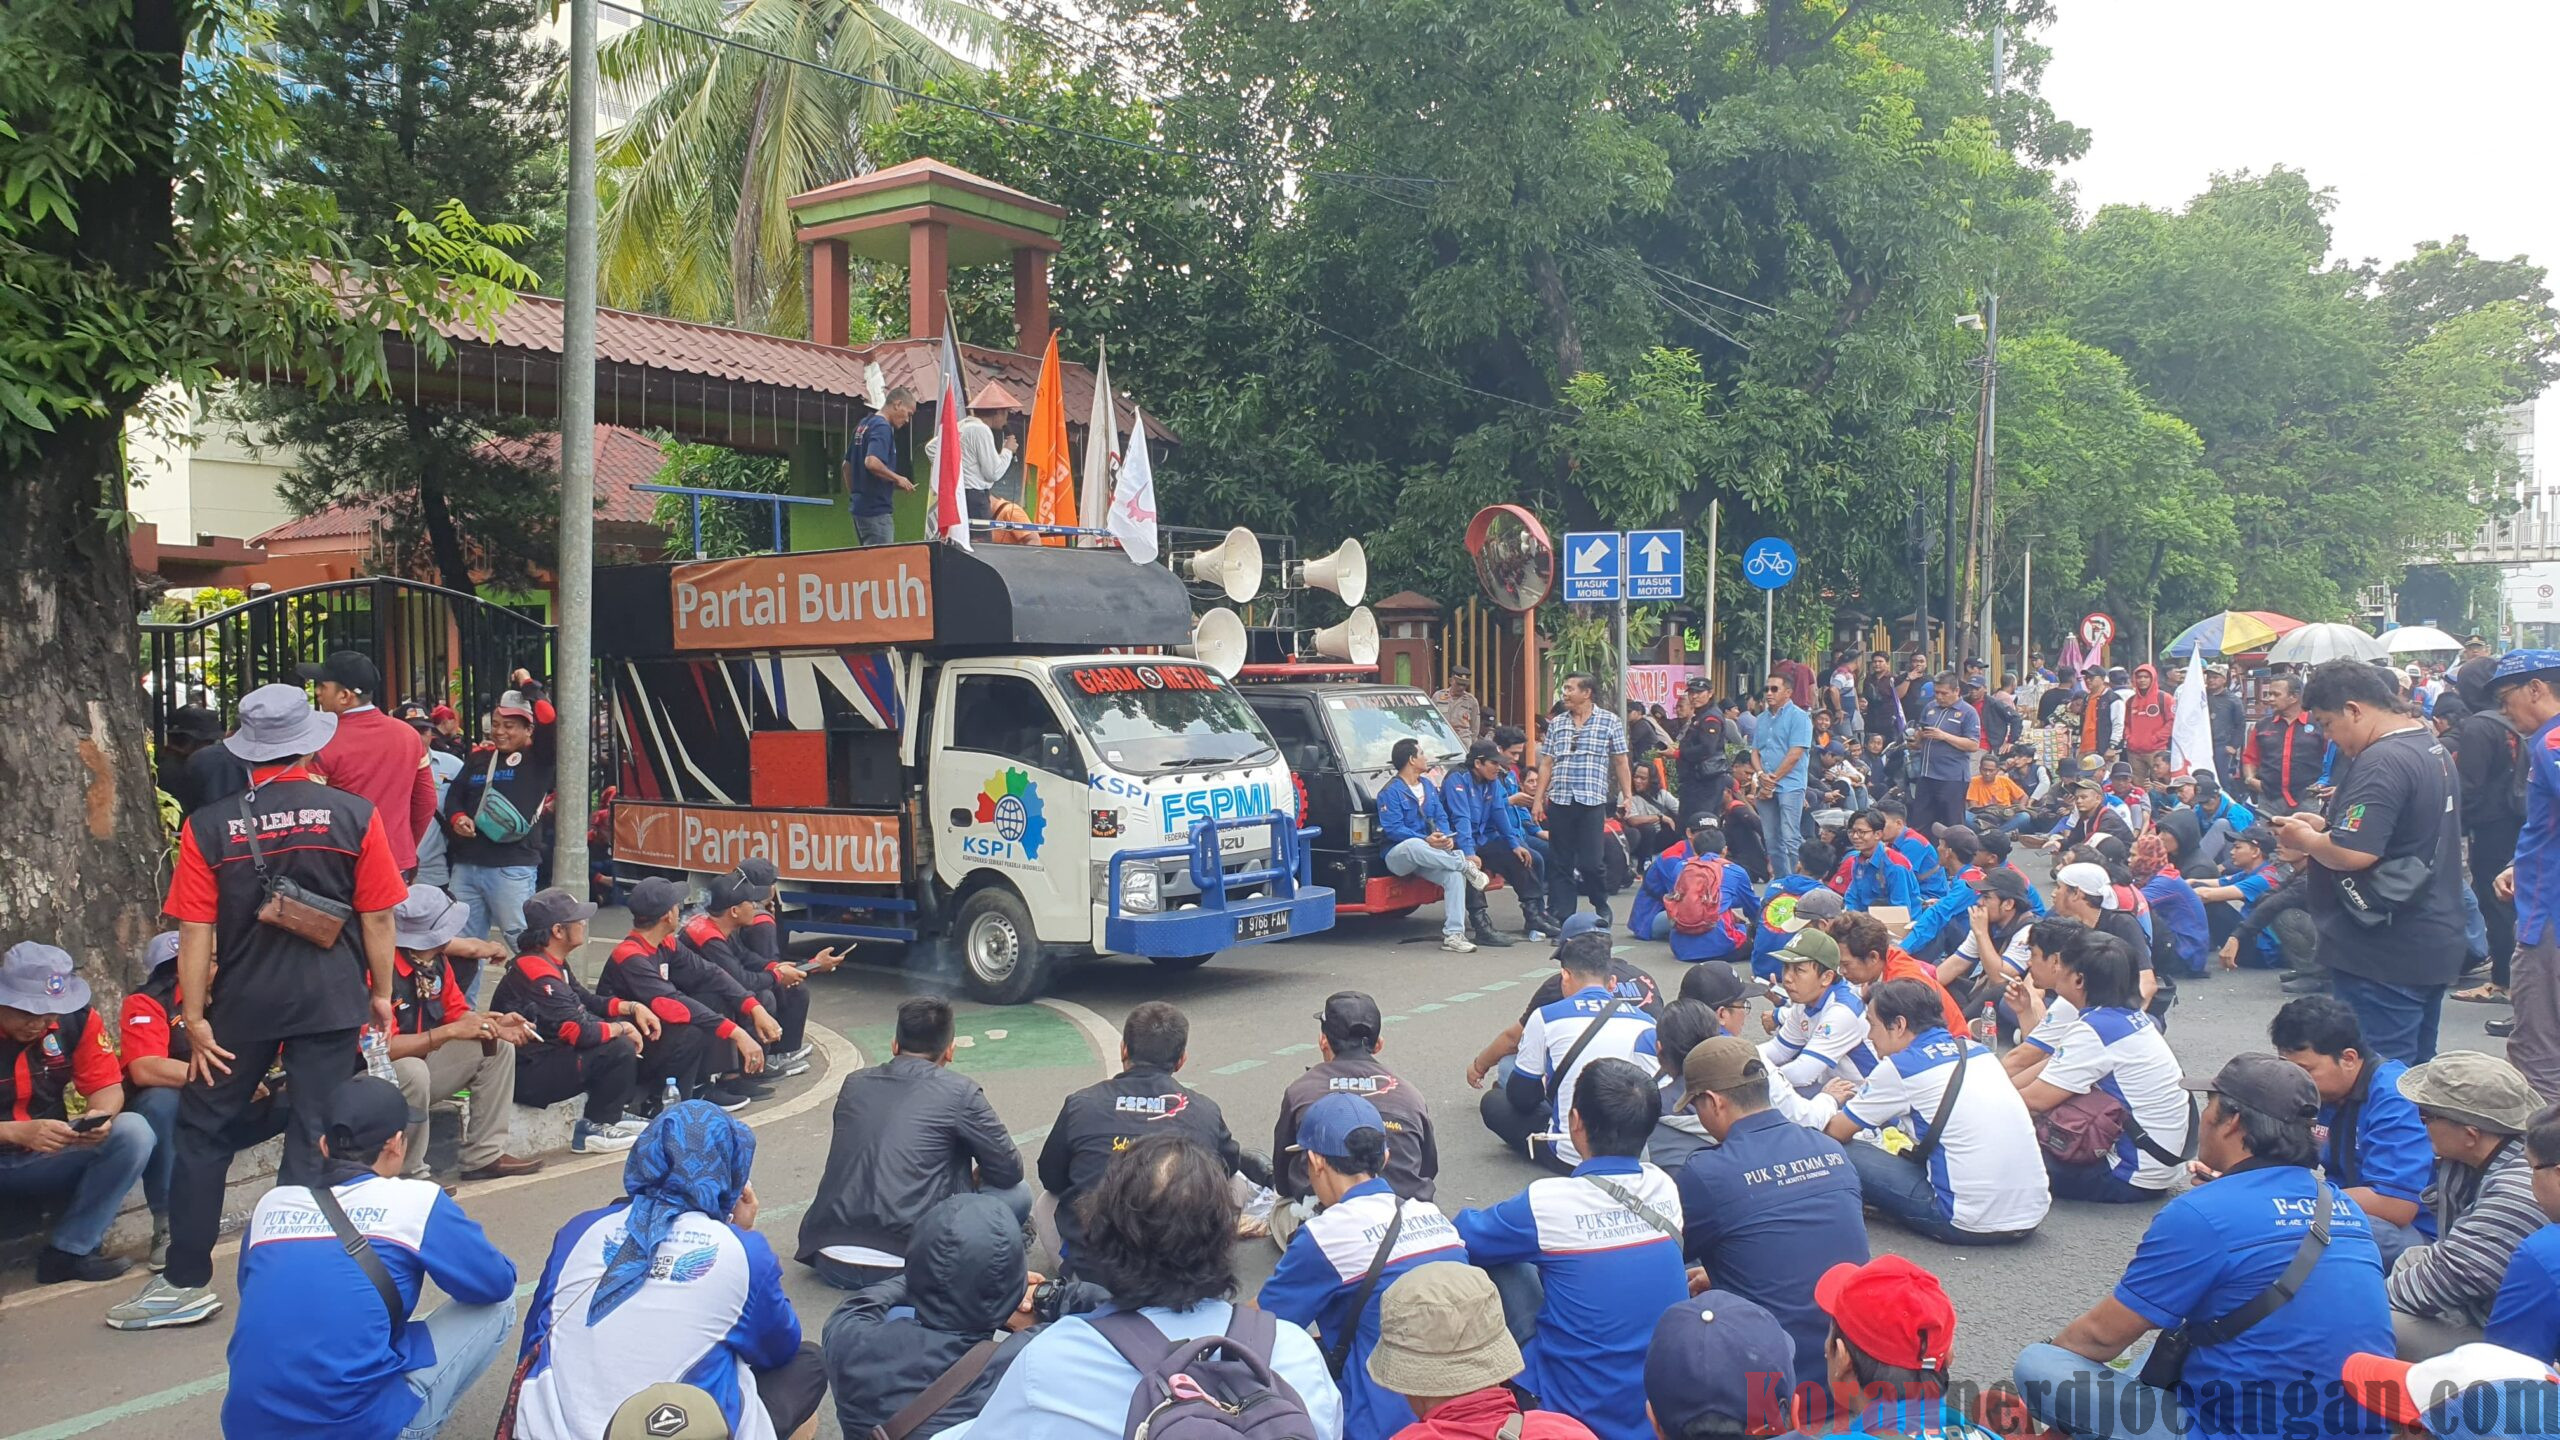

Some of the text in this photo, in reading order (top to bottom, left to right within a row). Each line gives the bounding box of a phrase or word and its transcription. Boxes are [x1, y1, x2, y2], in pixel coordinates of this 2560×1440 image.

[1575, 580, 1608, 588] MASUK
[1637, 578, 1672, 587] MASUK
[1637, 587, 1672, 595] MOTOR
[676, 563, 926, 630] Partai Buruh
[1577, 589, 1607, 597] MOBIL
[1073, 665, 1221, 694] GARDA METAL
[1089, 773, 1151, 807] KSPI
[1162, 782, 1272, 834] FSPMI
[261, 811, 296, 830] LEM
[299, 809, 331, 825] SPSI
[684, 815, 899, 873] Partai Buruh
[1164, 831, 1189, 843] FEDERAS
[1220, 837, 1244, 851] UZU
[963, 836, 1012, 859] KSPI
[1237, 911, 1287, 934] B 9766 FAW
[1610, 982, 1641, 998] PMI
[1922, 1043, 1961, 1060] FSP
[1329, 1077, 1377, 1091] FSPMI
[1115, 1095, 1166, 1113] FSPMI
[1744, 1153, 1845, 1185] PUK SP RTMM SPSI
[263, 1210, 290, 1226] PUK
[289, 1211, 309, 1225] SP
[353, 1207, 388, 1222] SPSI
[1575, 1211, 1606, 1230] PUK
[1606, 1210, 1621, 1227] SP
[683, 1231, 713, 1246] SPSI
